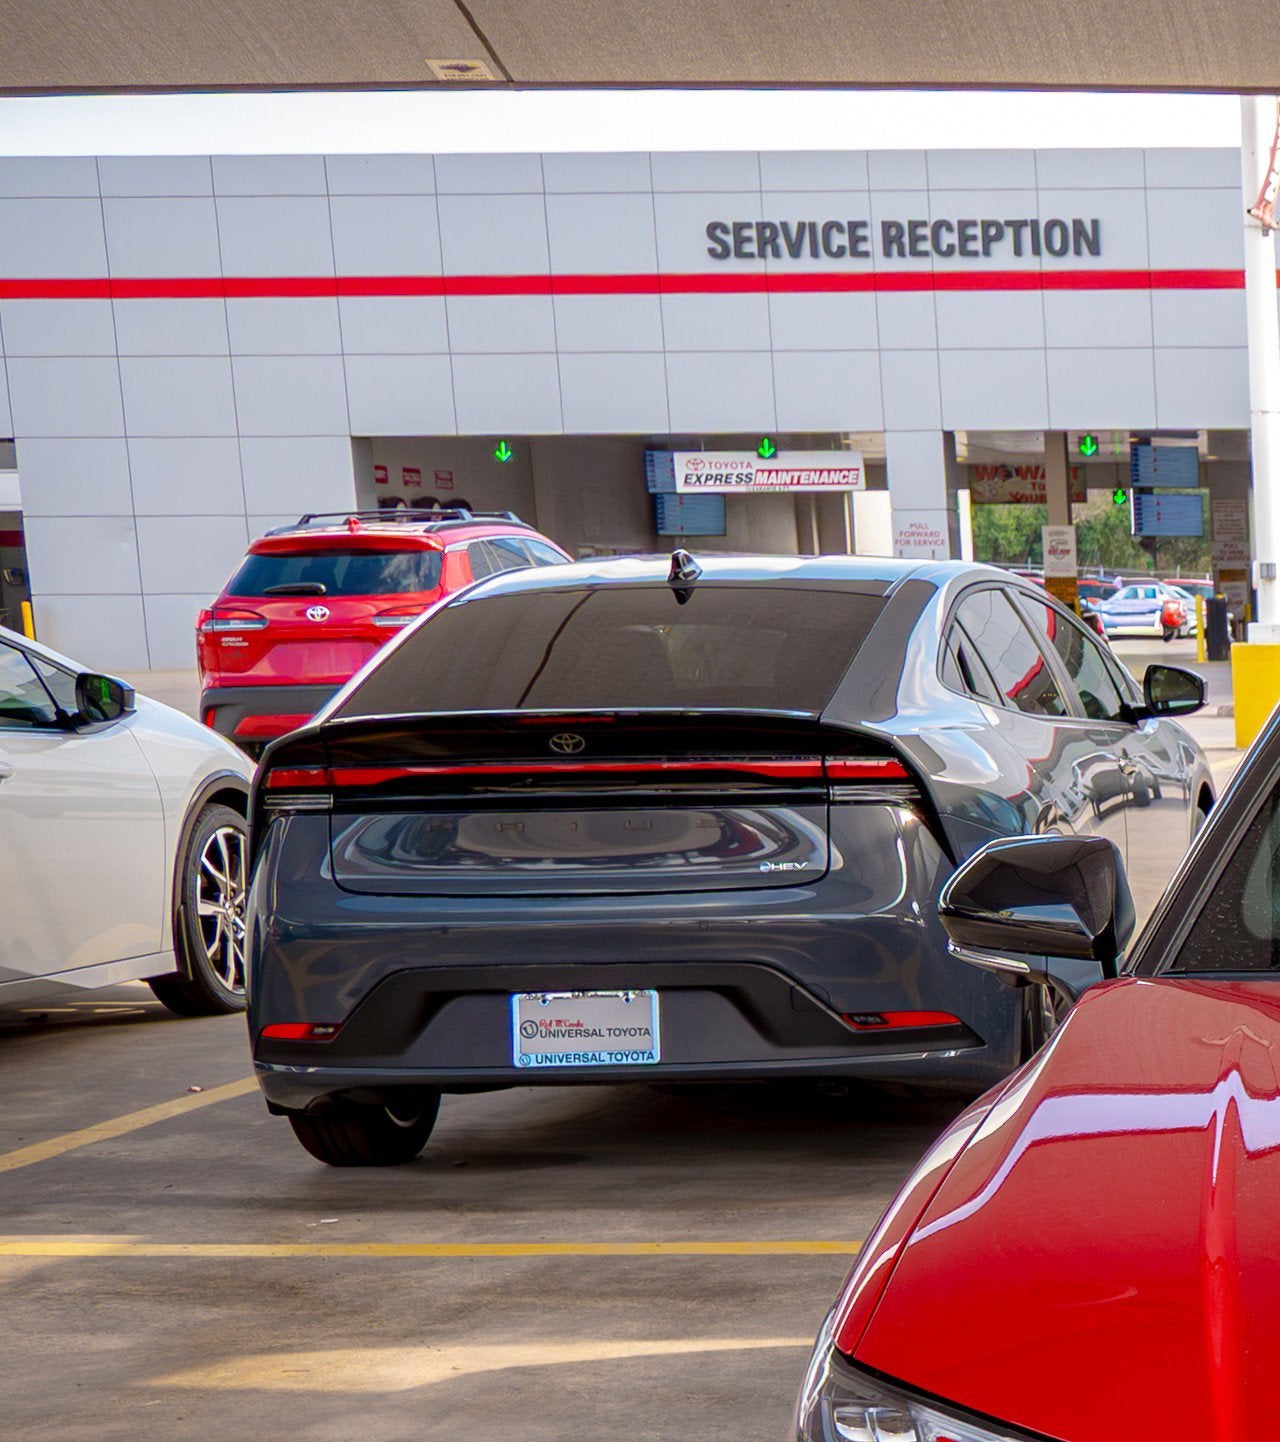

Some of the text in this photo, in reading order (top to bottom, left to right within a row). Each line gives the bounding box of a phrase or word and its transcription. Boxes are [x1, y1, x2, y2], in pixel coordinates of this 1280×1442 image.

[705, 219, 1101, 259] SERVICE RECEPTION
[706, 460, 753, 470] TOYOTA
[683, 470, 859, 485] EXPRESS MAINTENANCE
[771, 861, 809, 872] HEV
[540, 1028, 605, 1039] UNIVERSAL
[607, 1027, 651, 1037] TOYOTA
[535, 1053, 605, 1065] UNIVERSAL
[608, 1051, 655, 1063] TOYOTA
